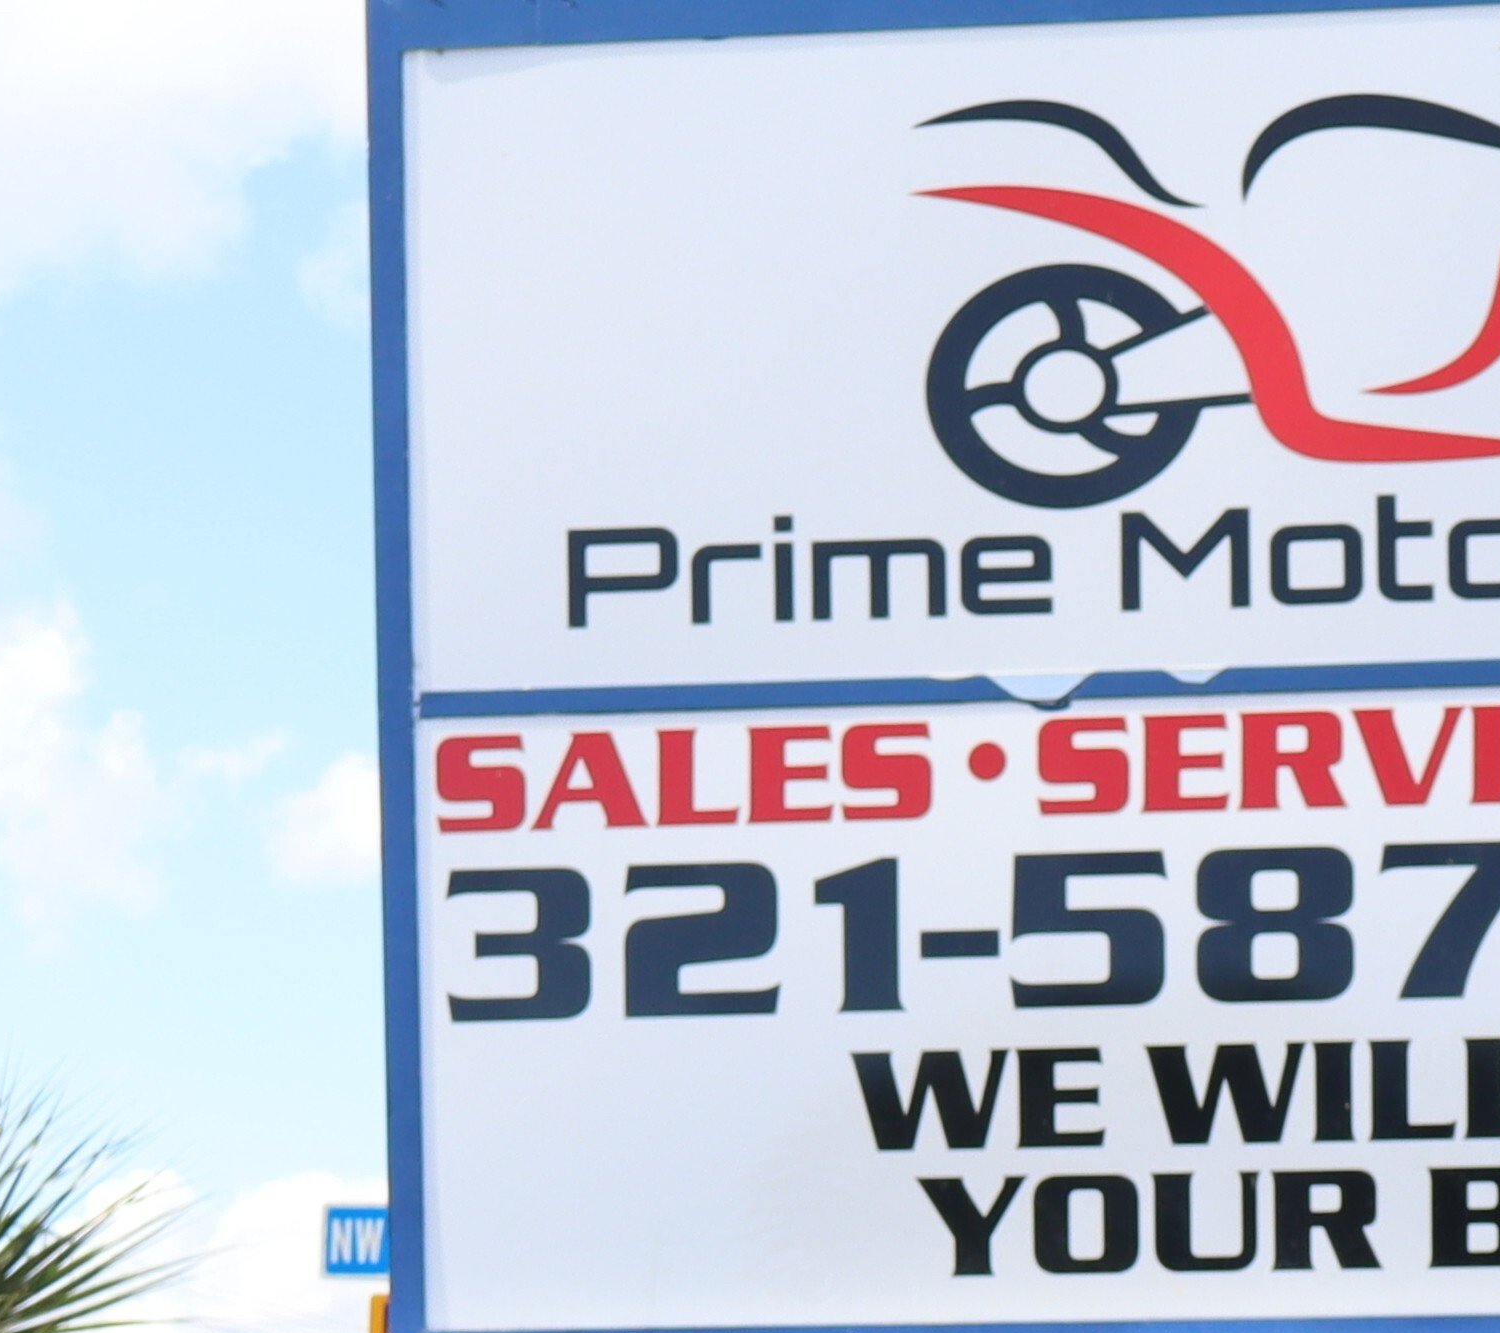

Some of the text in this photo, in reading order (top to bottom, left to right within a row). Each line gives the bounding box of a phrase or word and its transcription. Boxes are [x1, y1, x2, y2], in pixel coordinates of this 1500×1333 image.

[567, 516, 1052, 628] Prime
[436, 722, 932, 833] SALES
[852, 1047, 1105, 1151] WE
[330, 1218, 386, 1265] NW
[918, 1169, 1381, 1276] YOUR
